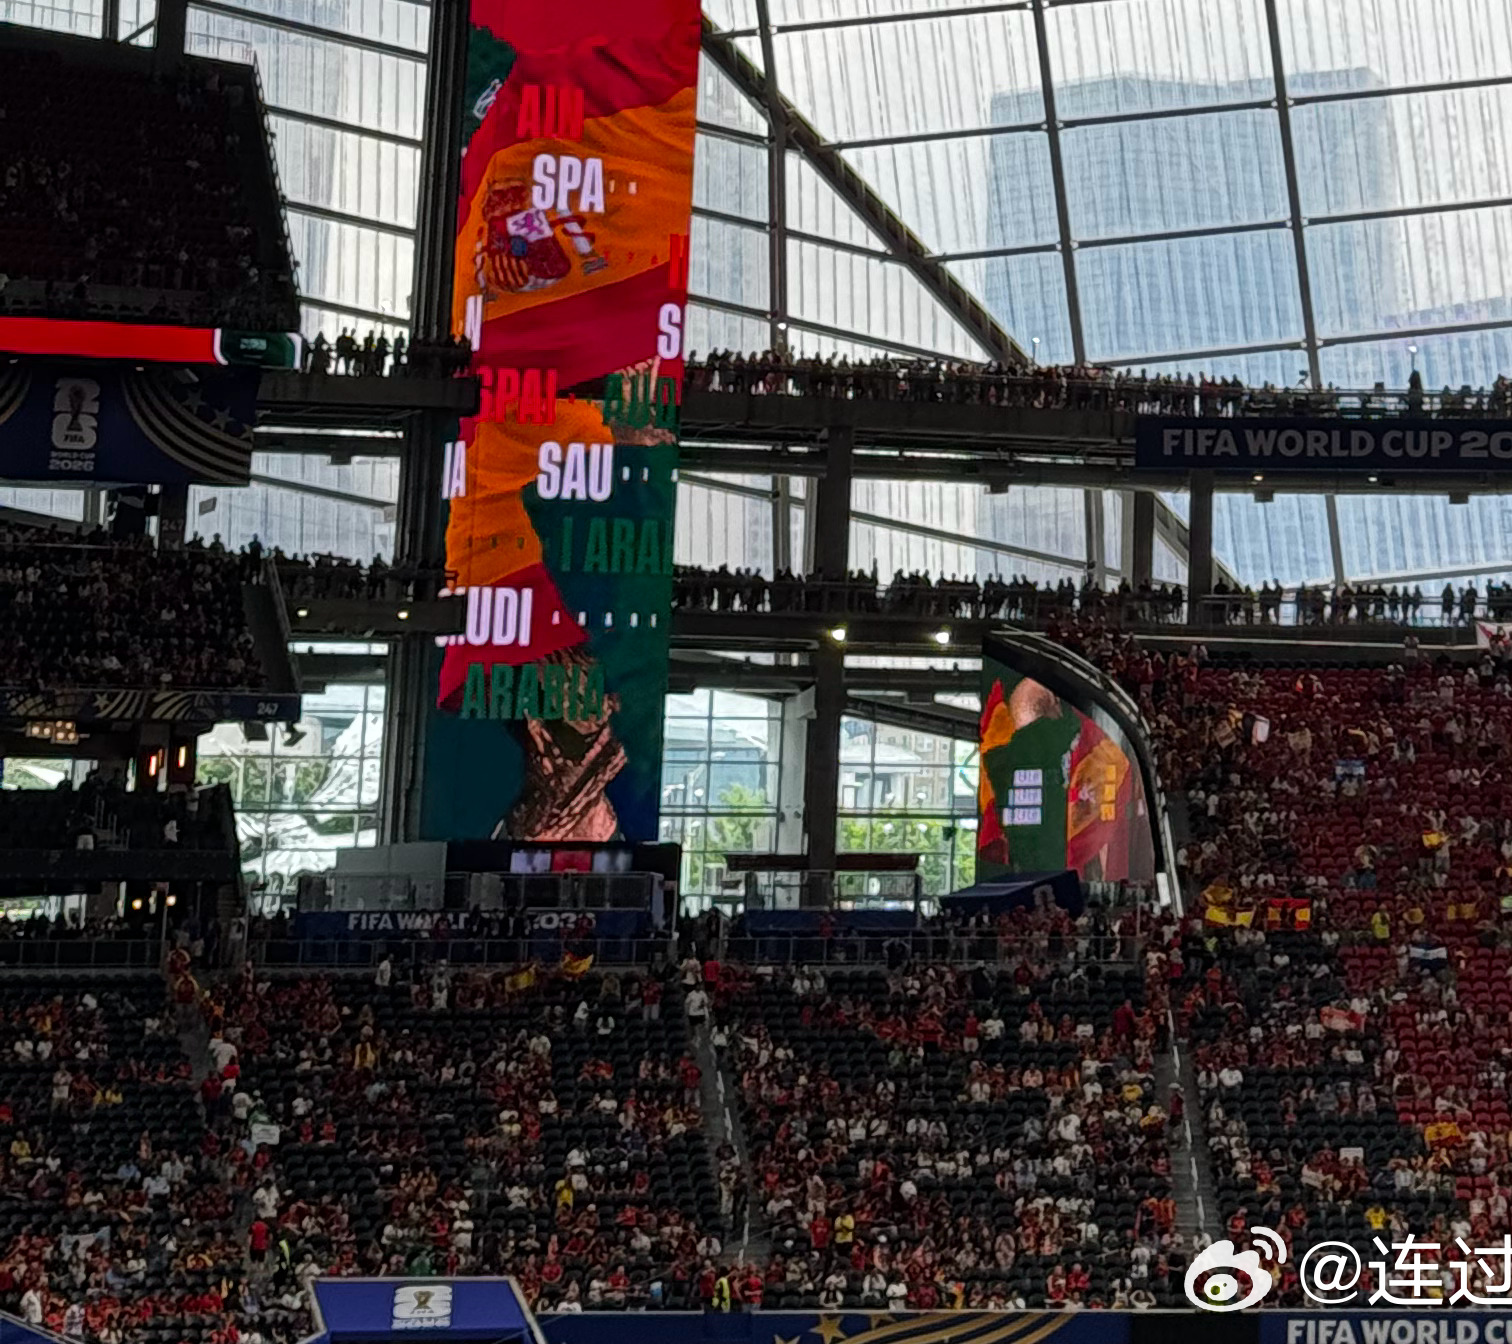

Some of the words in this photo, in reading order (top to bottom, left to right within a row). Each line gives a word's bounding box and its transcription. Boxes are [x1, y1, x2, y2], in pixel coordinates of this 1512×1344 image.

[1162, 428, 1239, 456] FIFA
[1245, 429, 1375, 458] WORLD
[1382, 430, 1453, 458] CUP
[348, 913, 393, 931] FIFA
[1287, 1319, 1356, 1344] FIFA
[1360, 1319, 1479, 1344] WORLD
